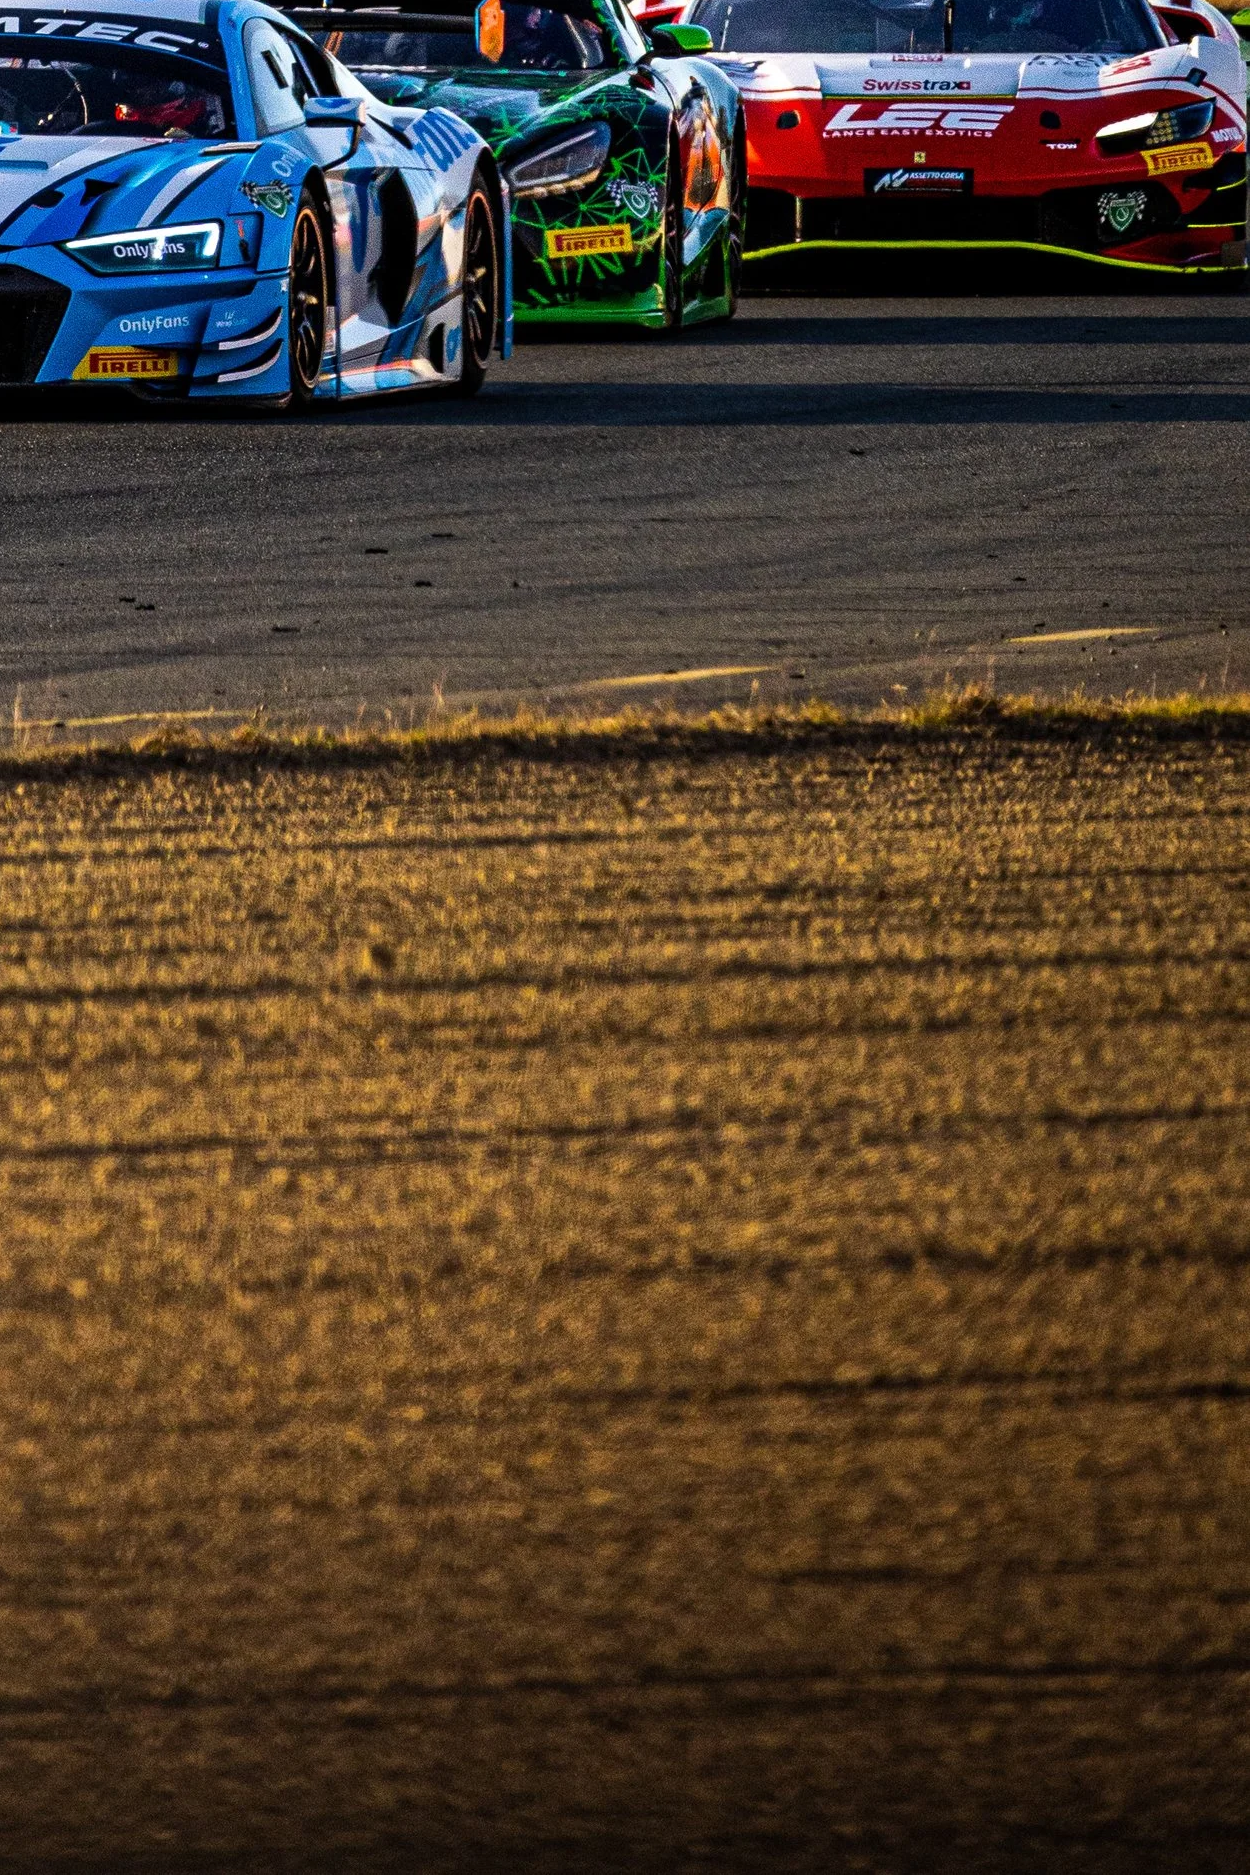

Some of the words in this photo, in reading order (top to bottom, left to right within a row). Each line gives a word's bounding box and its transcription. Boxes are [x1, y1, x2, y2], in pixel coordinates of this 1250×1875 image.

[863, 78, 961, 91] Swisstrax
[824, 103, 1015, 130] LEE
[823, 128, 876, 138] LANCE
[880, 128, 920, 136] EAST
[925, 128, 993, 138] EXOTICS
[1150, 146, 1208, 171] PIRELLI
[909, 171, 942, 180] ASSETTO
[942, 172, 965, 181] CORSA
[554, 228, 625, 252] PIRELLI
[119, 314, 190, 334] OnlyFans
[89, 351, 170, 374] PIRELLI
